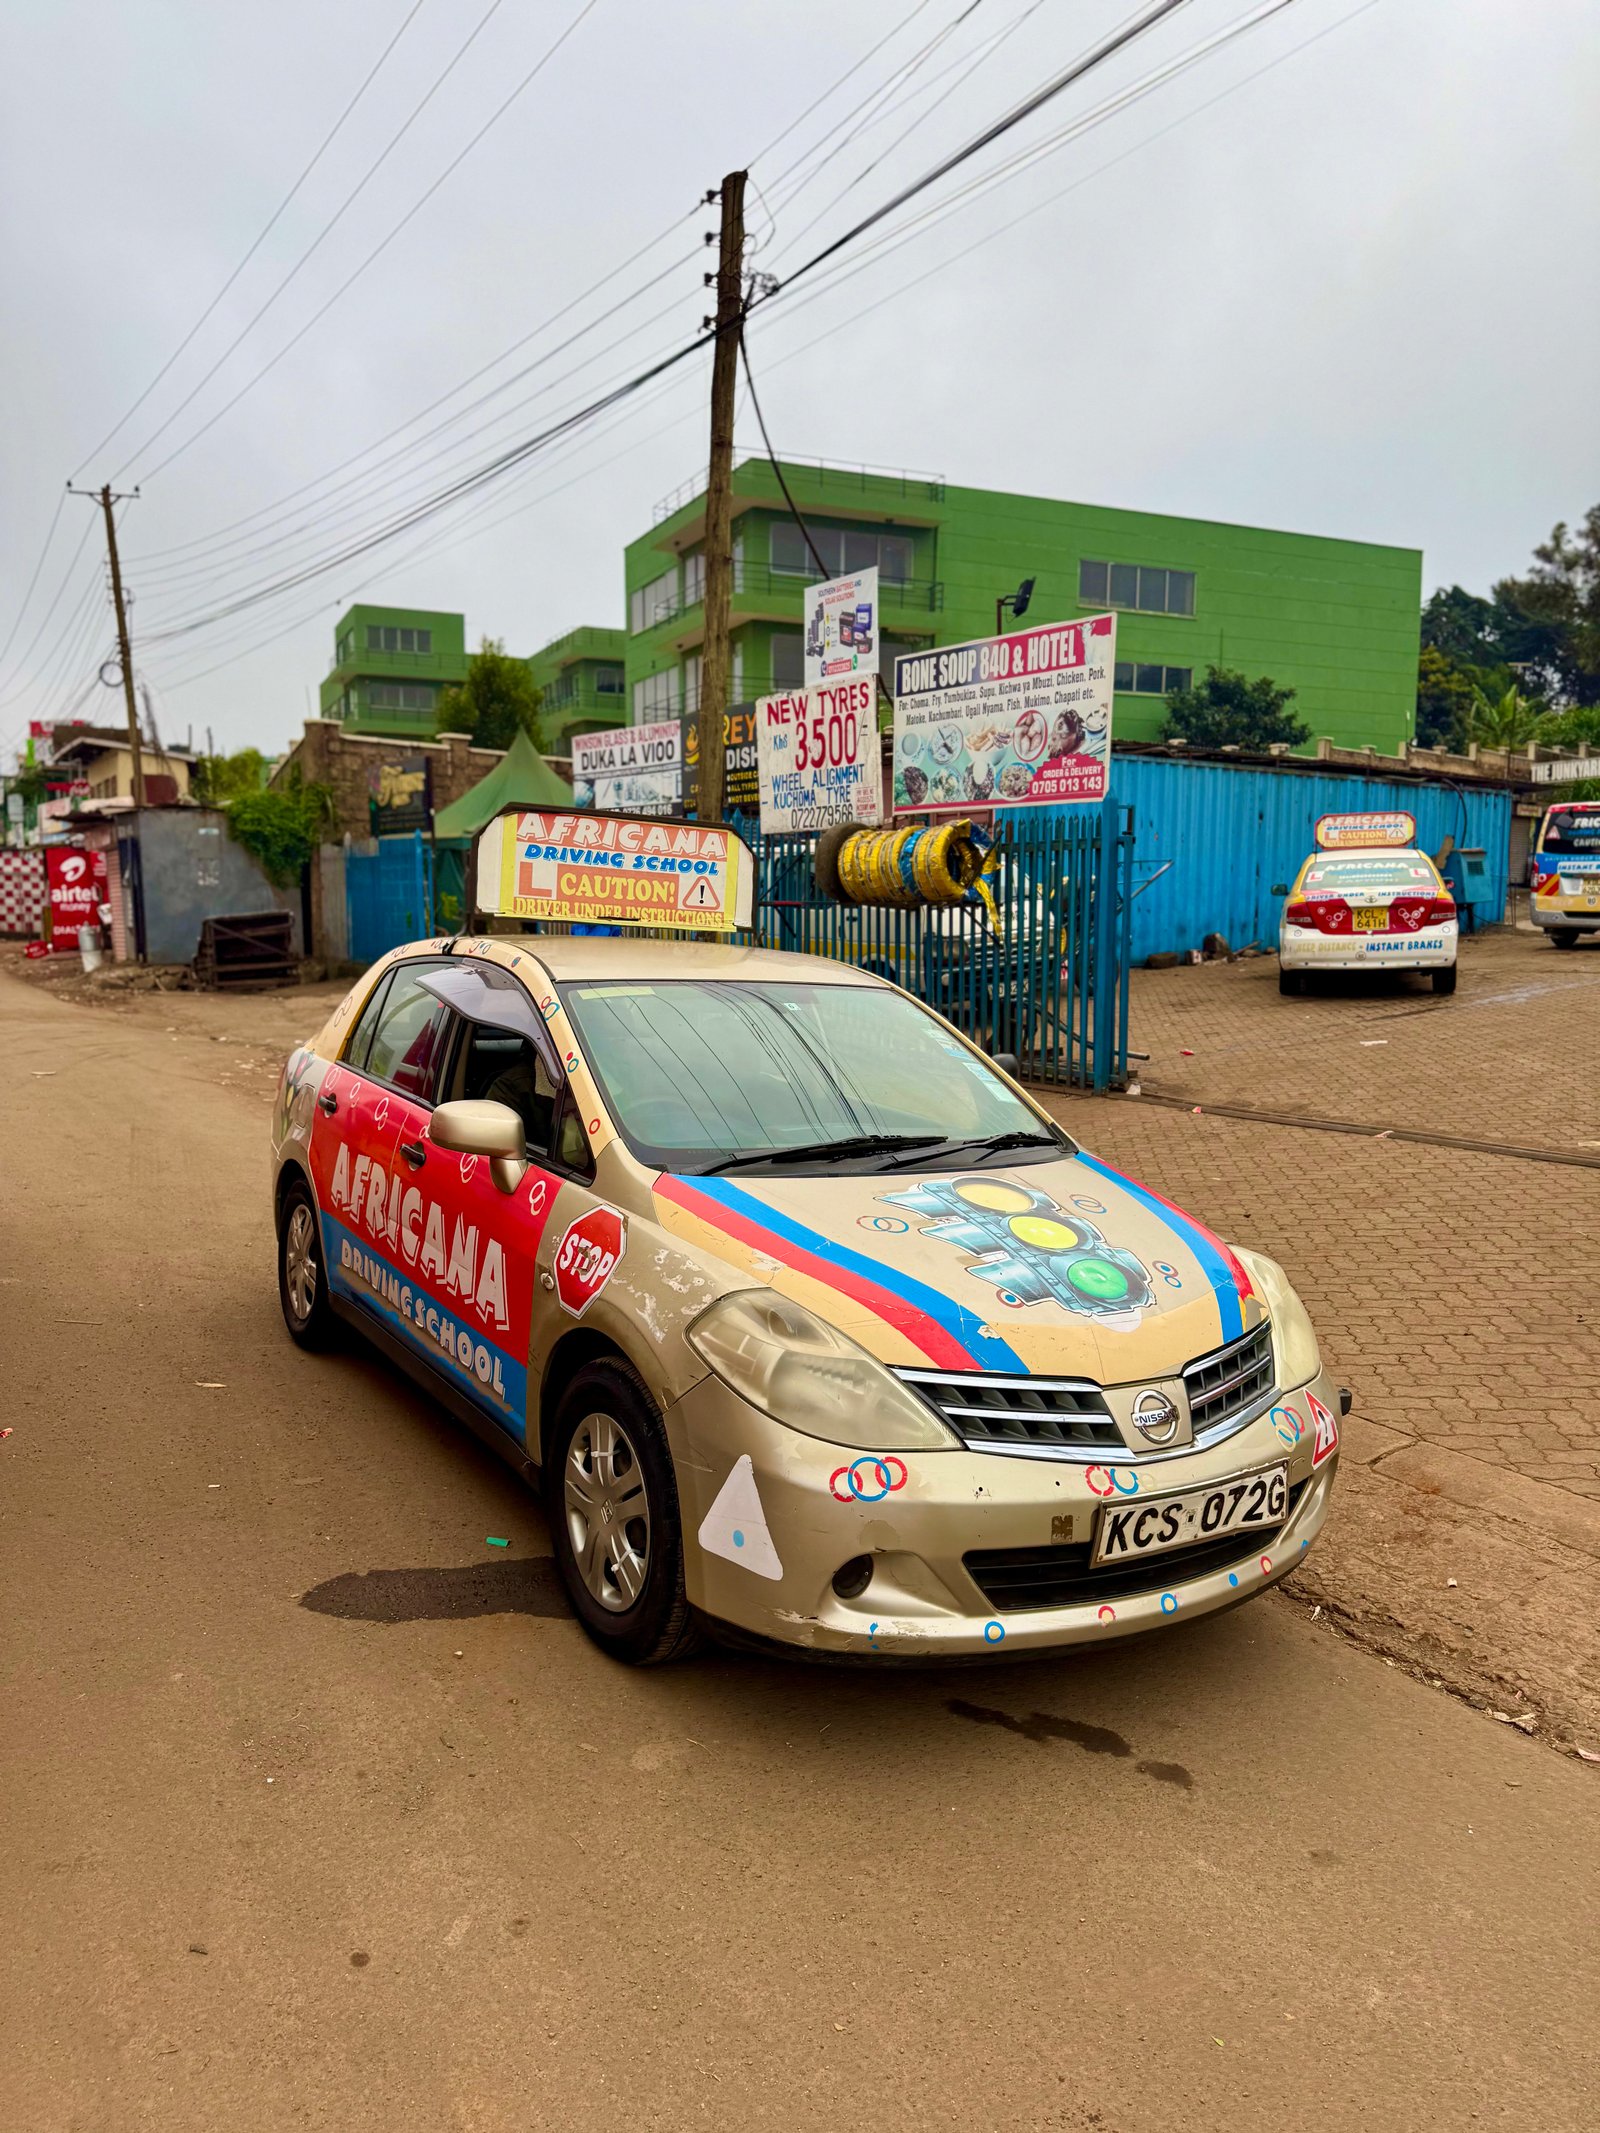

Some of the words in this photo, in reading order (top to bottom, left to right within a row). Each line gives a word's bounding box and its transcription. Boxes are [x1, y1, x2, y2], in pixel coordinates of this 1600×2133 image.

[902, 657, 937, 694] BONE
[939, 651, 976, 687] SOUP
[980, 643, 1010, 680] 840
[1012, 645, 1024, 674] &
[1027, 629, 1076, 672] HOTEL
[1023, 681, 1030, 694] ya
[1054, 688, 1080, 705] Chapati
[767, 695, 808, 726] NEW
[817, 682, 869, 717] TYRES
[604, 730, 628, 747] GLASS
[630, 731, 635, 743] &
[581, 749, 616, 771] DUKA
[621, 745, 637, 766] LA
[642, 740, 674, 763] VIOO
[1062, 757, 1076, 766] For
[772, 773, 805, 792] WHEEL
[812, 764, 864, 788] ALIGNMENT
[1043, 769, 1063, 779] ORDER
[1071, 766, 1102, 776] DELIVERY
[1531, 764, 1550, 782] THE
[1552, 760, 1600, 780] JUNKYAR
[730, 784, 741, 792] ALL
[742, 782, 758, 791] TYPES
[1032, 780, 1057, 794] 0705
[1060, 778, 1079, 792] 013
[1083, 776, 1102, 790] 143
[731, 795, 742, 803] HOT
[826, 785, 851, 804] TYRE
[658, 804, 672, 815] 016
[791, 804, 853, 829] 0722779566
[1323, 815, 1408, 826] AFRICANA
[517, 813, 727, 859] AFRICANA
[1339, 830, 1386, 840] CAUTION!
[524, 844, 625, 868] DRIVING
[634, 856, 719, 876] SCHOOL
[1324, 862, 1408, 871] AFRICANA
[52, 884, 99, 902] airtel
[560, 873, 676, 904] CAUTION!
[60, 903, 91, 914] money
[516, 898, 571, 916] DRIVER
[574, 903, 622, 918] UNDER
[626, 904, 722, 926] INSTRUCTIONS
[1357, 909, 1378, 919] KCL
[1357, 919, 1386, 928] 641H
[1366, 942, 1405, 951] INSTANT
[1408, 940, 1443, 950] BRAKES
[331, 1142, 509, 1331] AFRICANA
[560, 1234, 615, 1288] STOP
[341, 1239, 411, 1319] DRIVING
[415, 1298, 506, 1401] SCHOOL
[1138, 1407, 1178, 1425] NISSAN
[1106, 1503, 1182, 1555] KCS
[1201, 1475, 1285, 1532] 072G
